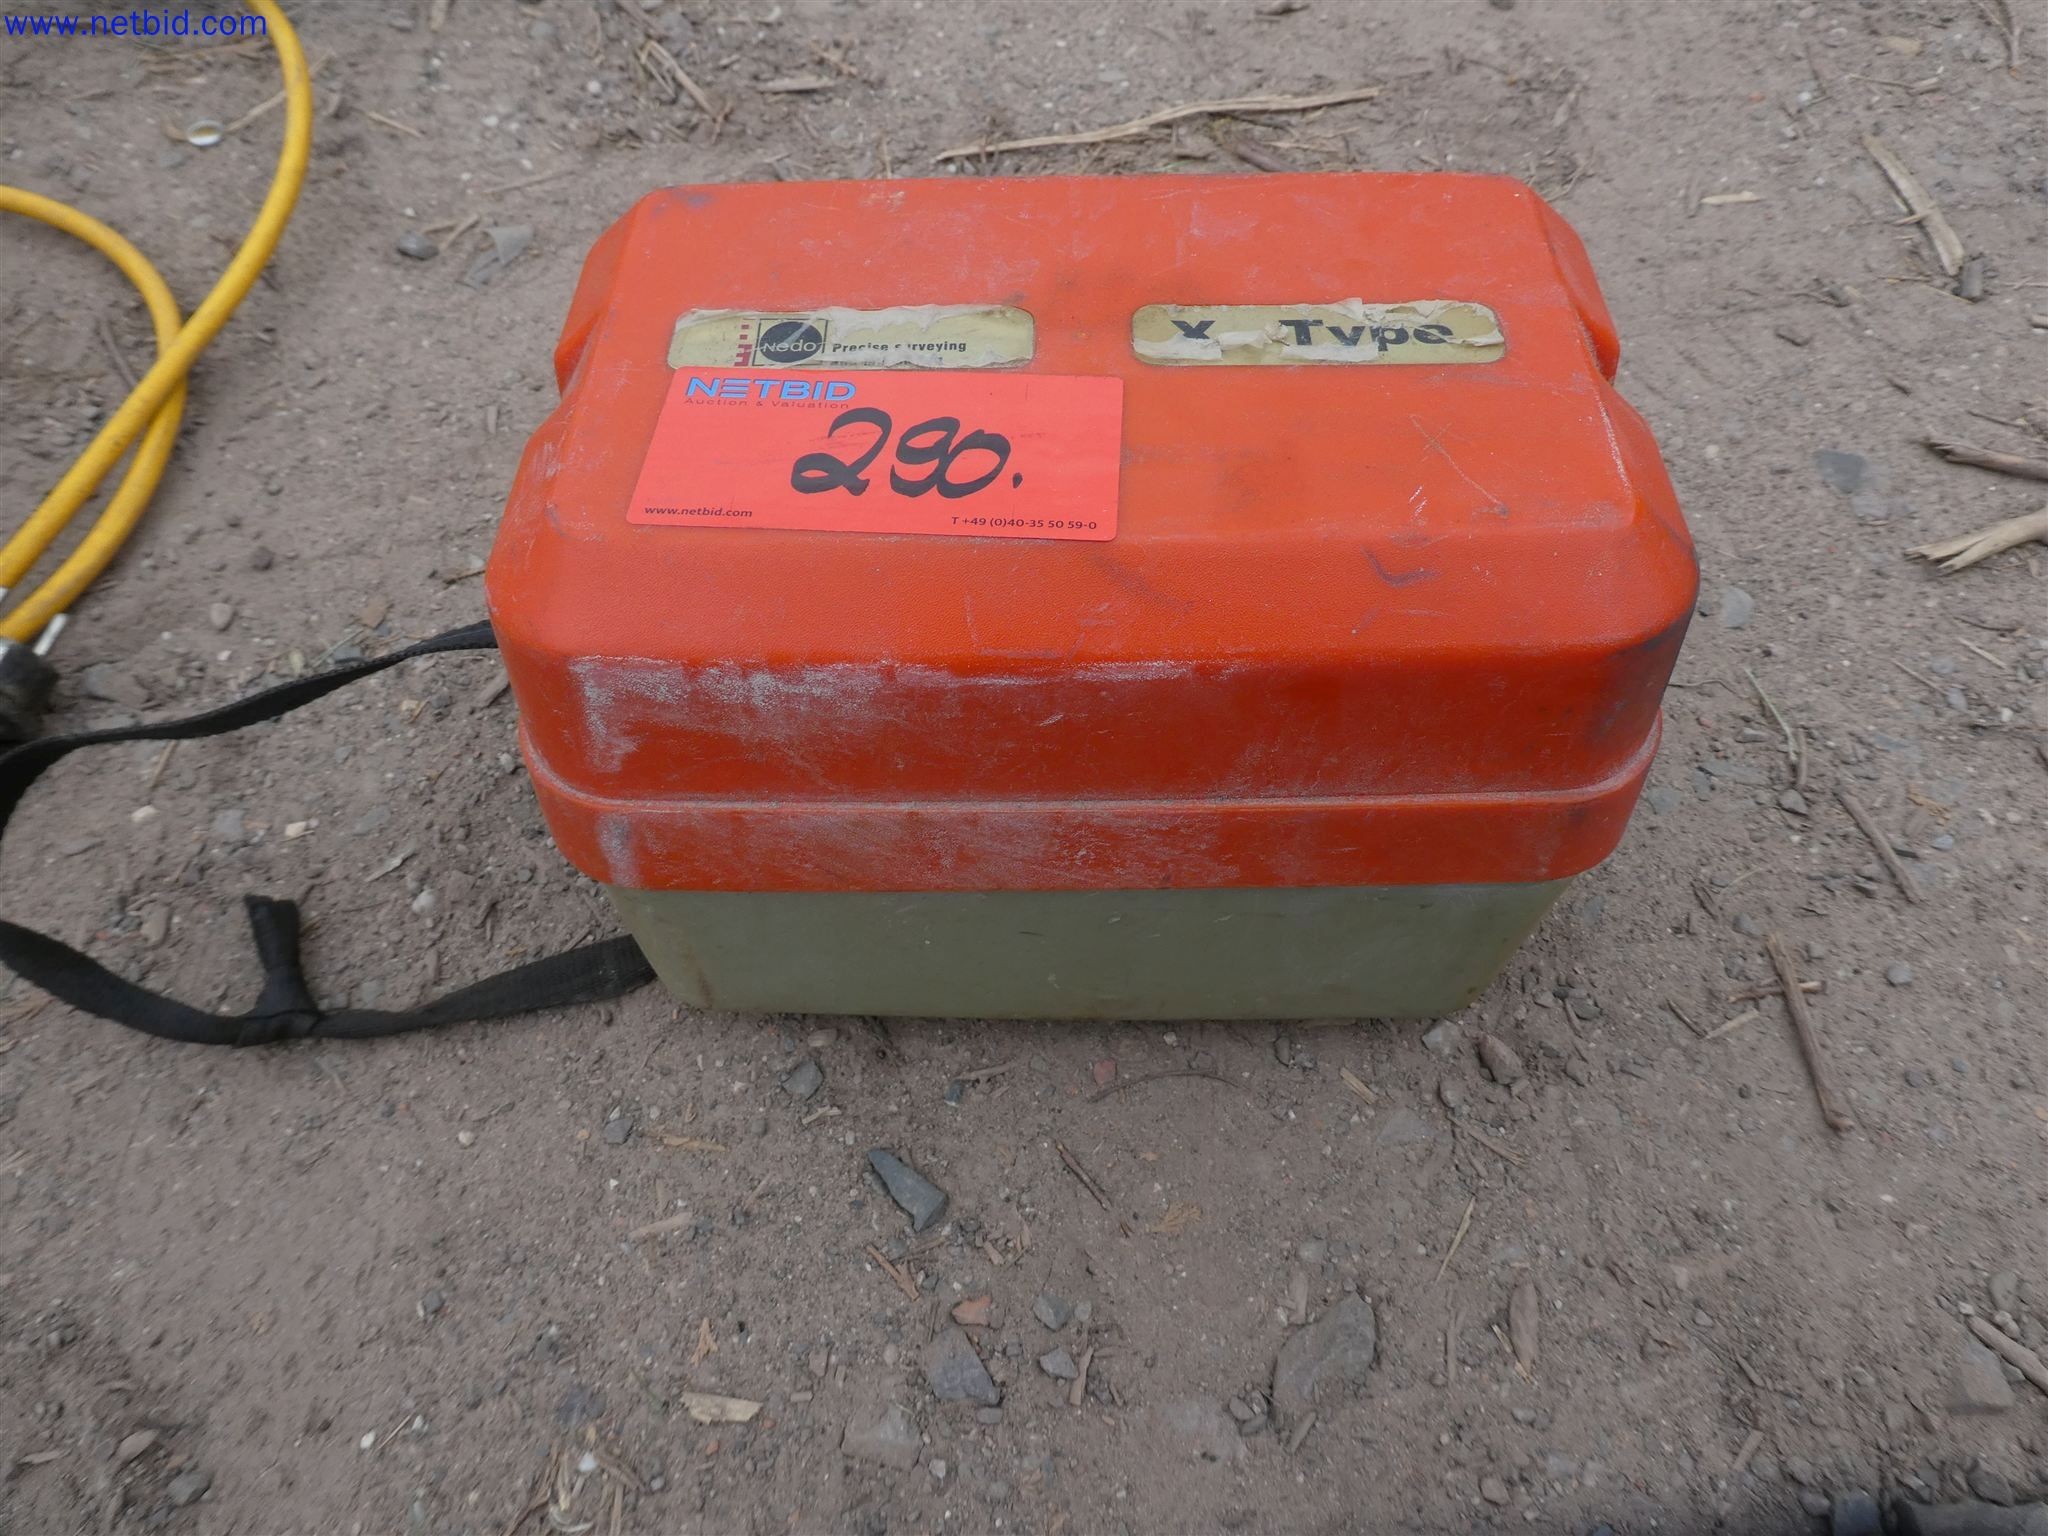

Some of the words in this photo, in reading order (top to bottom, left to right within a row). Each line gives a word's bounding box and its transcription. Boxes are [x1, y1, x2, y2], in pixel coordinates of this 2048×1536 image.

[1279, 319, 1454, 352] Type
[763, 339, 817, 353] Nedo
[832, 342, 888, 352] Precise
[685, 377, 857, 402] NETBID
[685, 397, 748, 407] Auction
[755, 400, 764, 408] &
[771, 400, 849, 410] Valuation
[644, 506, 753, 518] www.netbid.com
[951, 516, 960, 526] T
[962, 517, 987, 527] +49
[989, 517, 1044, 529] (0)40-35
[1047, 519, 1064, 529] 50
[1067, 520, 1098, 530] 59-0
